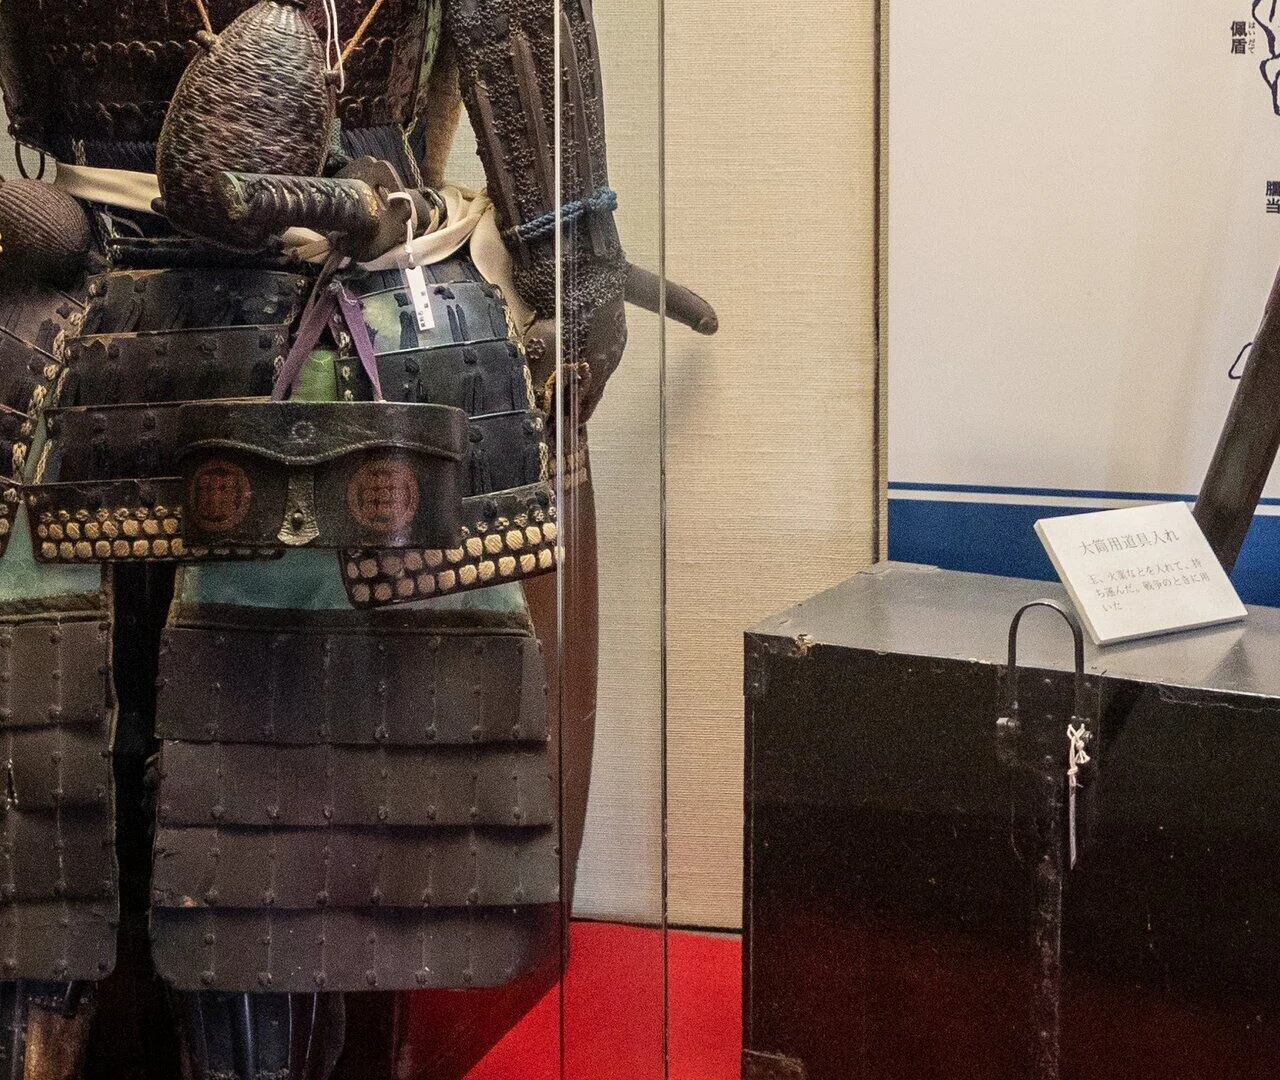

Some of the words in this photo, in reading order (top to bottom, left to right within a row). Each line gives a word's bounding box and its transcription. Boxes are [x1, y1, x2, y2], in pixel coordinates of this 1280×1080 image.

[1079, 529, 1180, 556] 大筒用道具入れ
